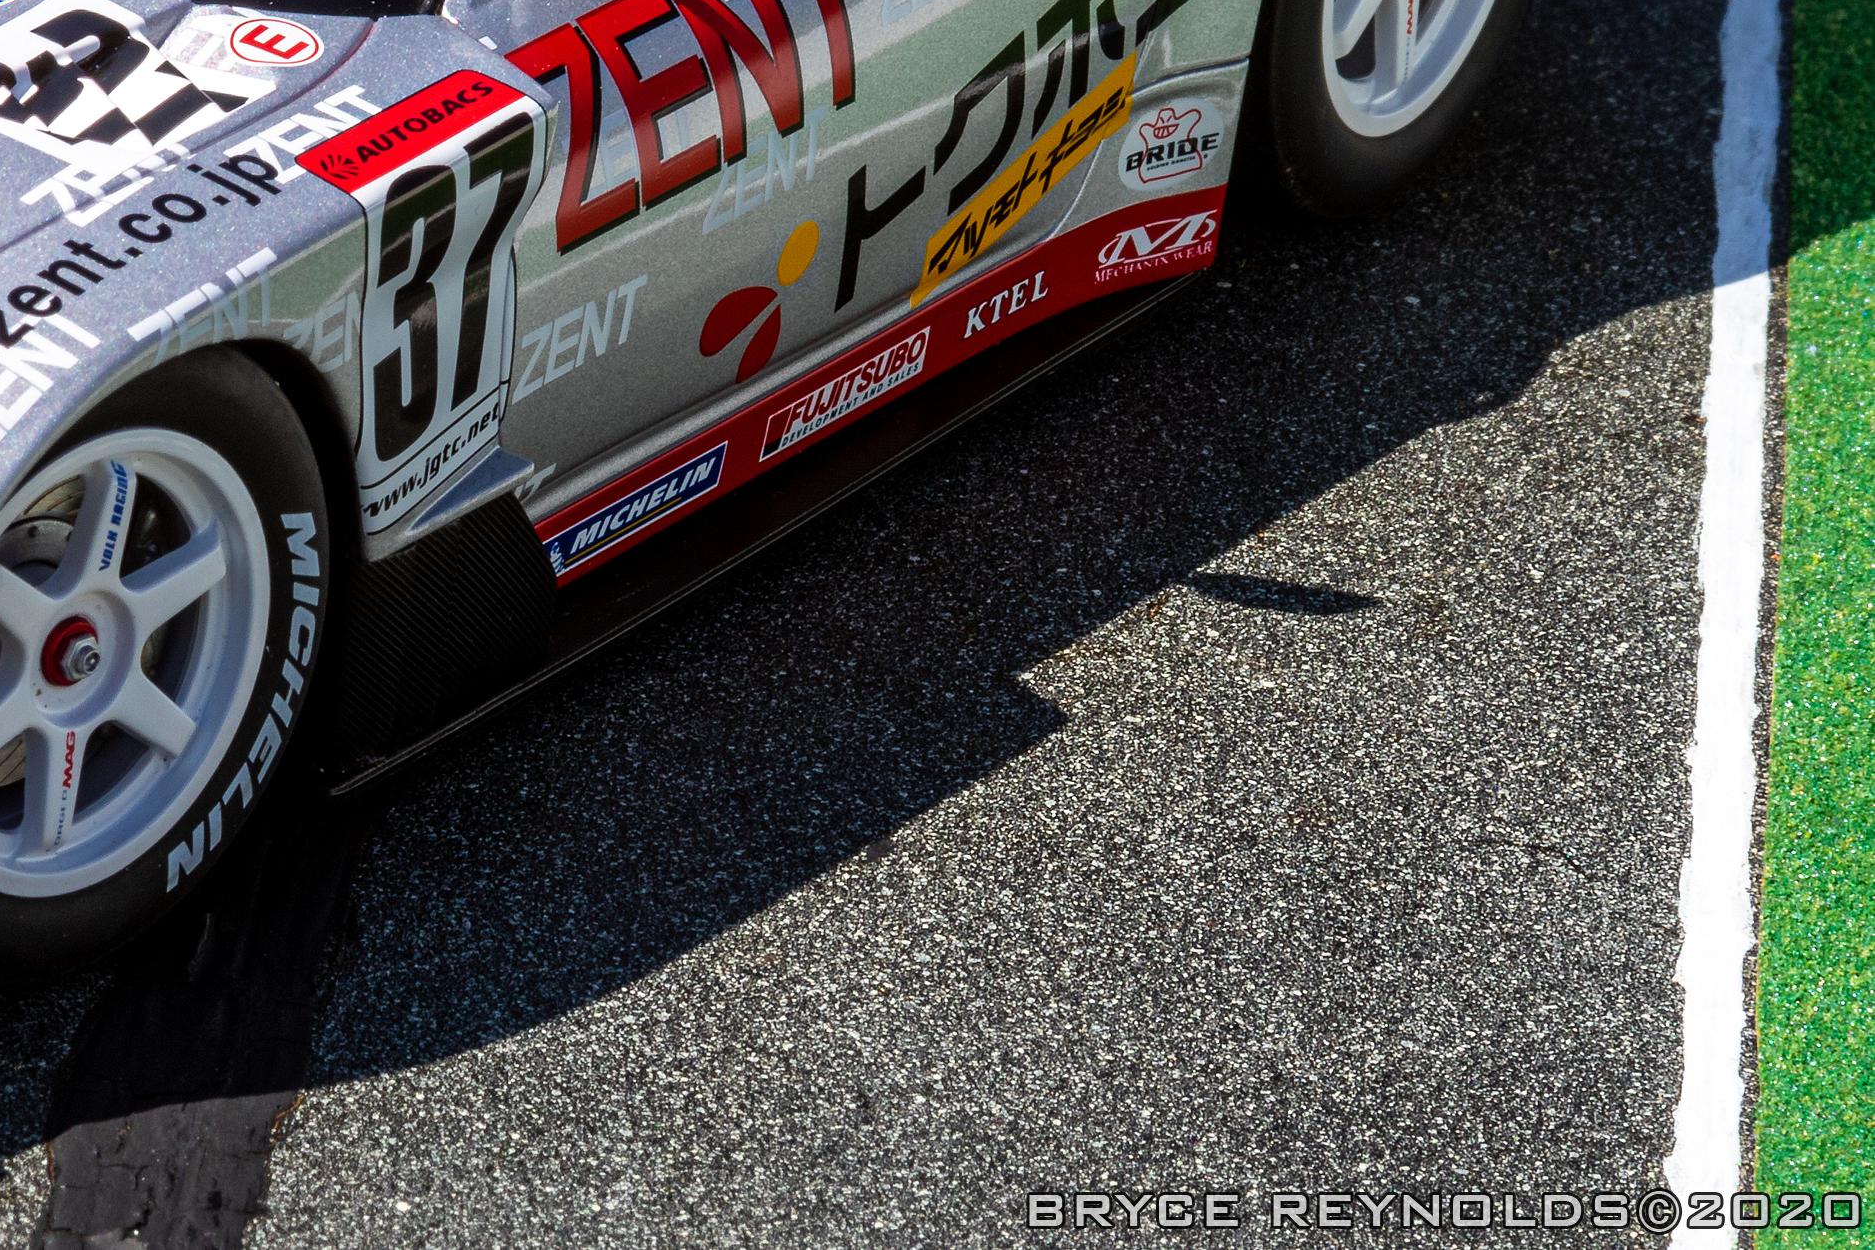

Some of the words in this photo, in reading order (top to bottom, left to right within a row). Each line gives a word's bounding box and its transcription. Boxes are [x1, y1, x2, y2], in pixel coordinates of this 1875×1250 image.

[355, 78, 495, 165] AUTOBACS
[1125, 132, 1221, 173] BRIDE
[372, 111, 536, 461] 37
[963, 270, 1049, 340] KTEL
[1093, 256, 1169, 284] MECHANIX
[1173, 240, 1214, 262] WEAR
[283, 291, 362, 373] ZEN
[512, 275, 648, 406] ZENT
[781, 397, 860, 449] DEVELOPMENT
[861, 383, 885, 402] AND
[887, 361, 921, 388] SALES
[783, 332, 927, 436] FUJITSUBO
[359, 401, 500, 519] www.jgtc.net
[569, 445, 717, 556] MICHELIN
[166, 512, 323, 893] MICHELIN
[61, 730, 78, 789] MAG
